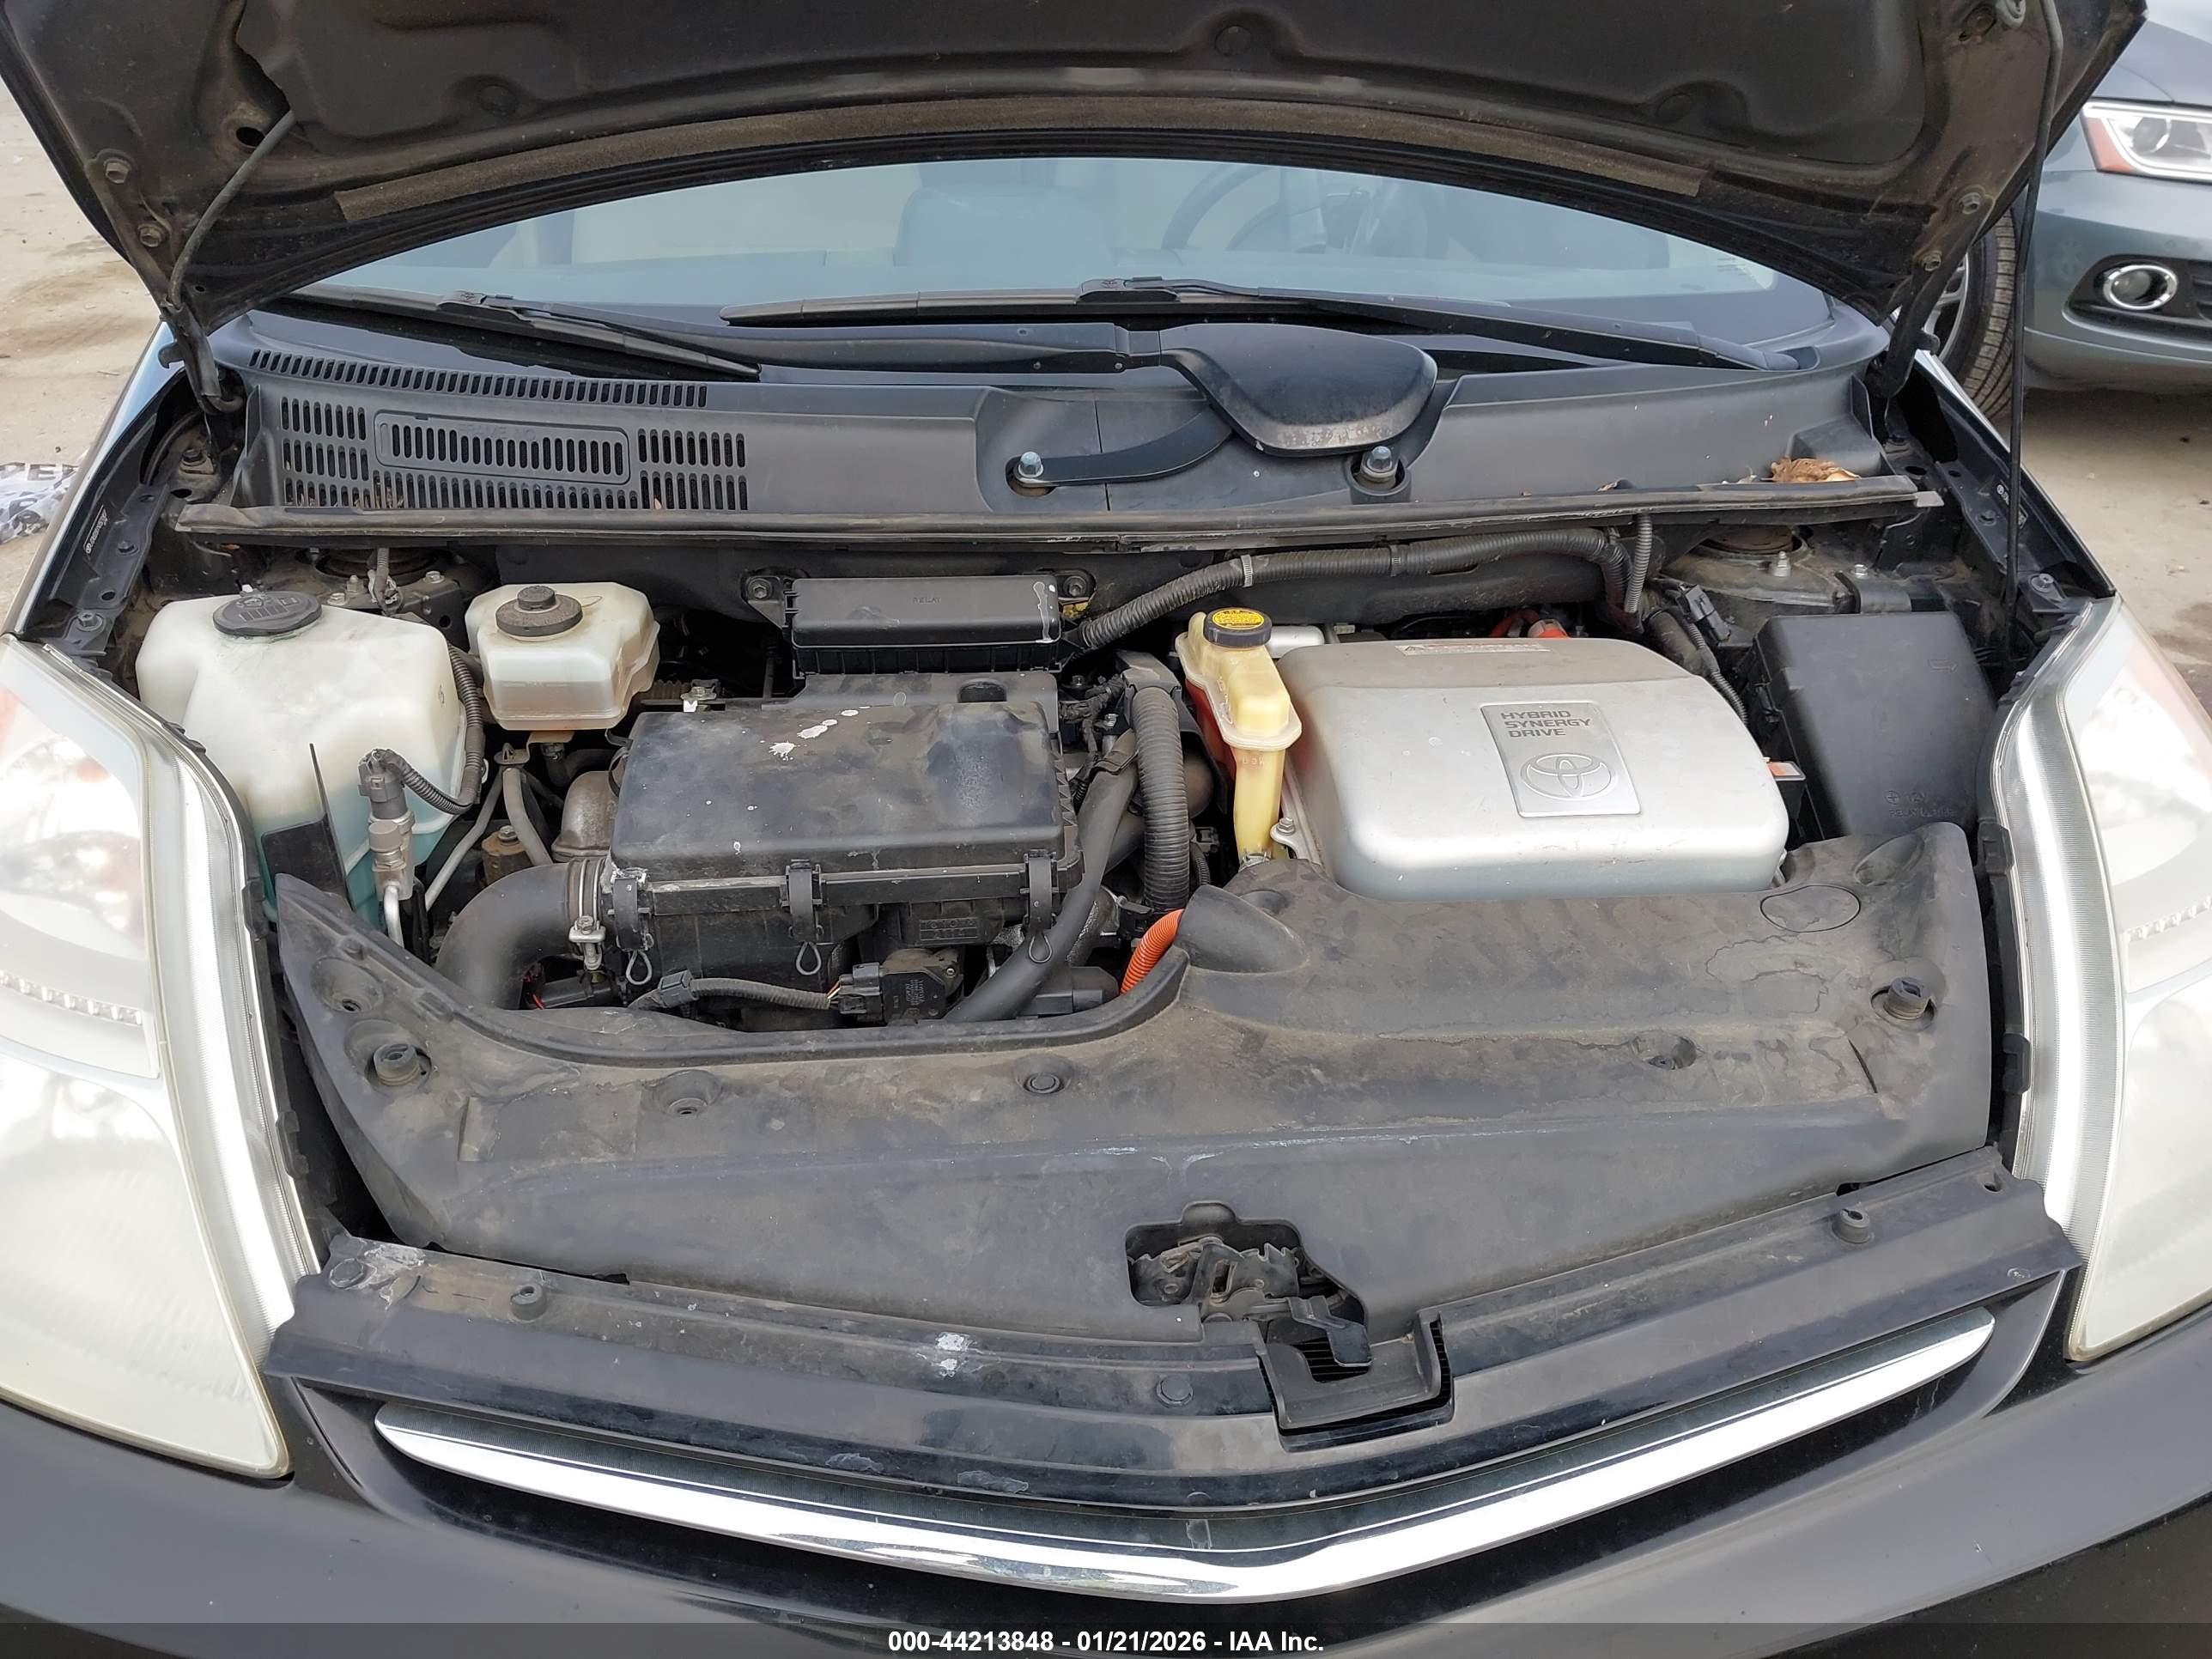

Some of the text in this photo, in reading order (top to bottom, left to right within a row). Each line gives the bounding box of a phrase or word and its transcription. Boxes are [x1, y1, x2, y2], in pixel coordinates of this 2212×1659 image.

[1500, 709, 1571, 720] HYBRID
[1504, 718, 1591, 729] SYNERGY
[1510, 727, 1567, 738] DRIVE
